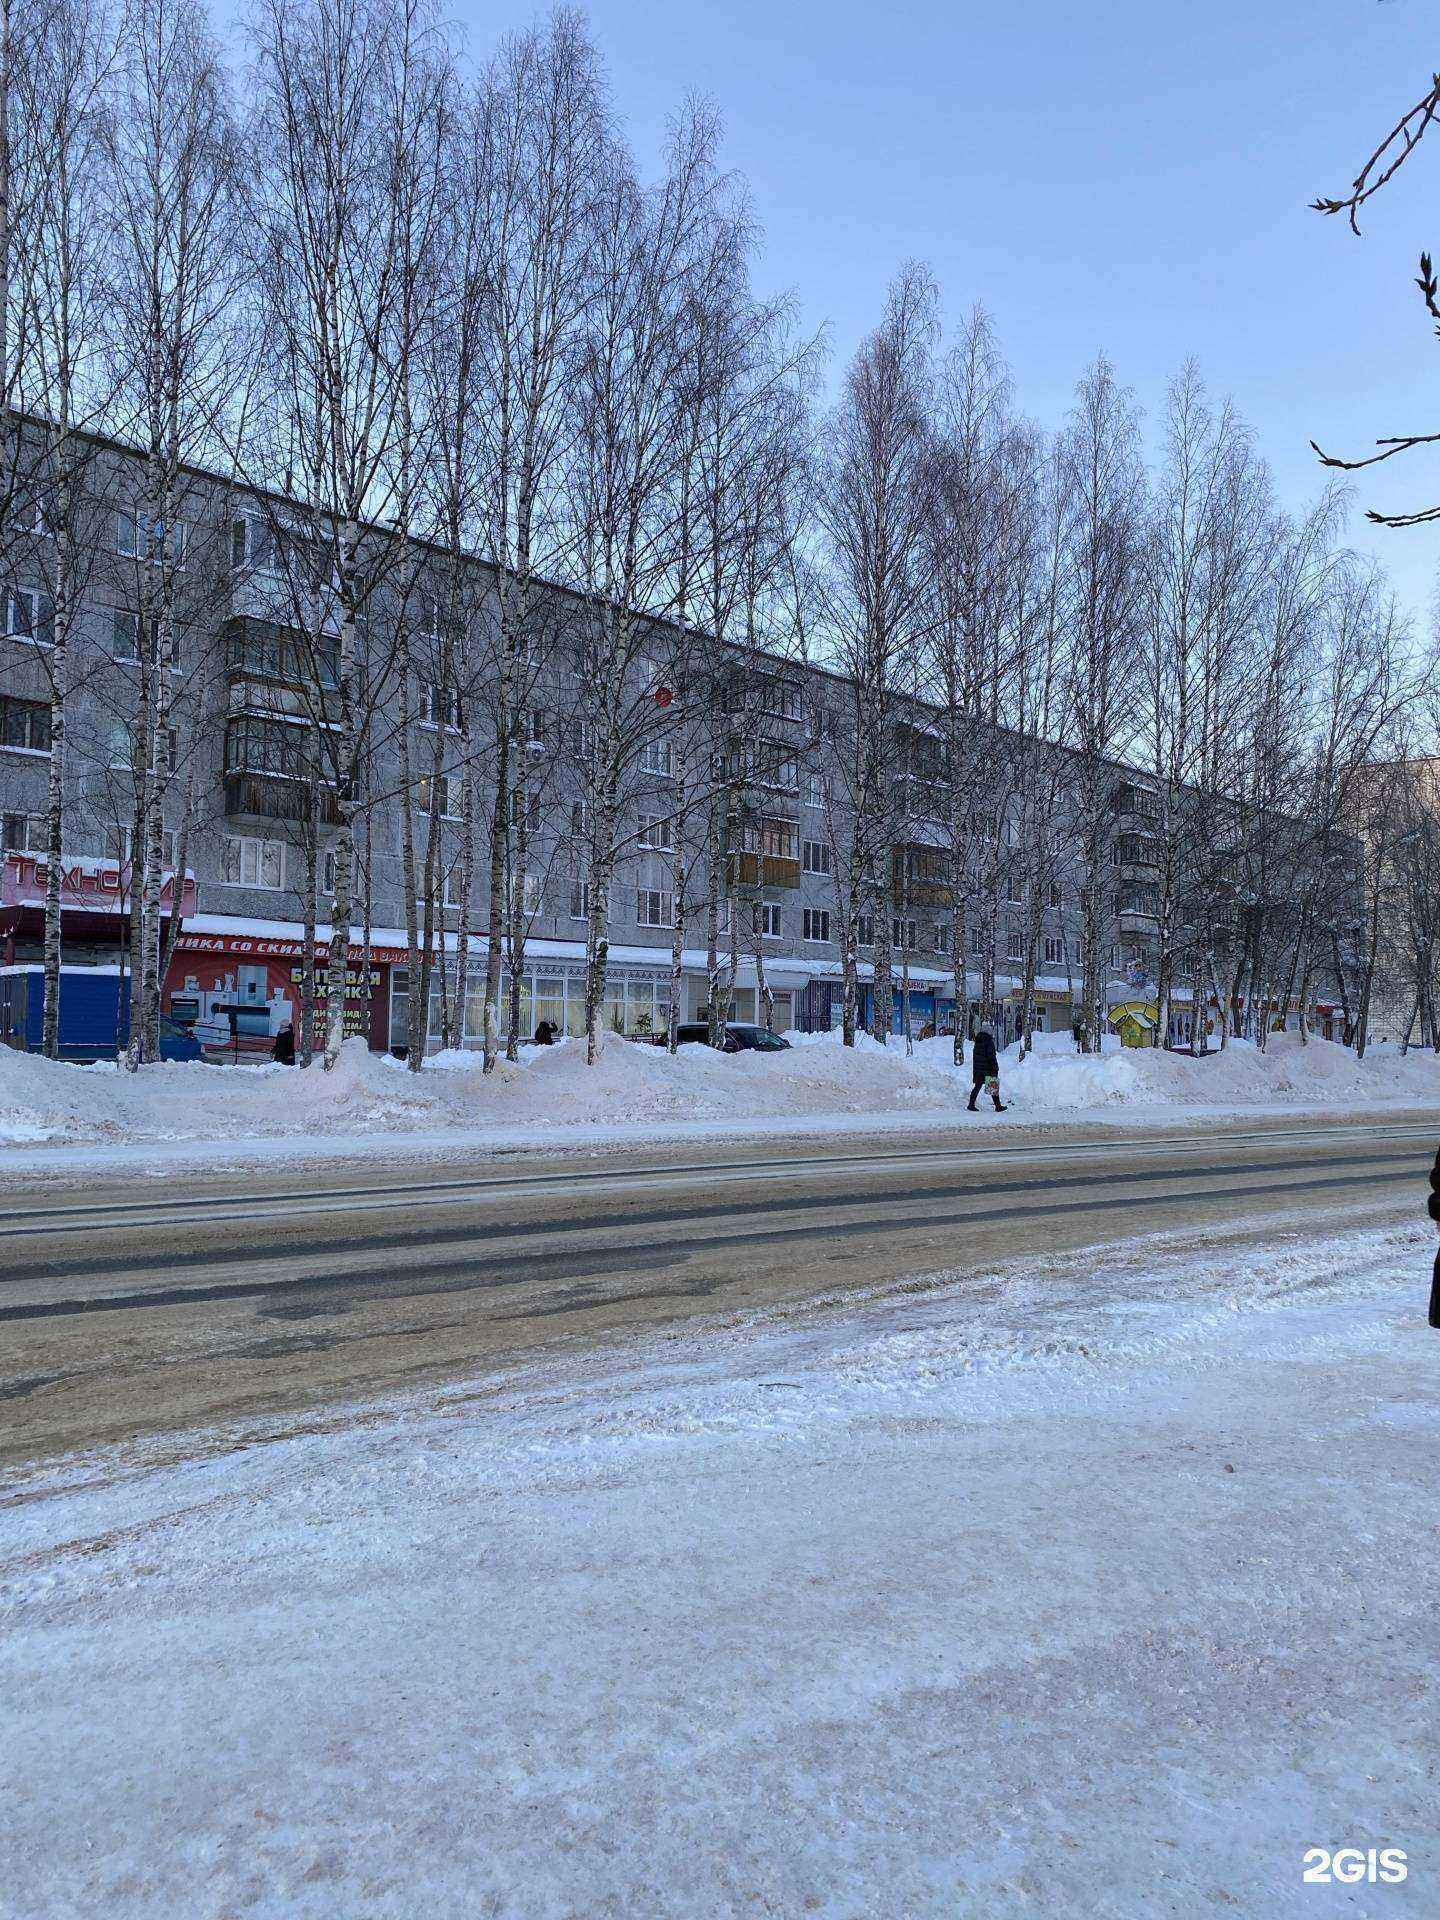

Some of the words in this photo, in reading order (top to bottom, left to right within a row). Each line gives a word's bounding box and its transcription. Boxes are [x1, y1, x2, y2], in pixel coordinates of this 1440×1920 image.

[7, 856, 195, 898] ТЕХНОИР
[229, 941, 253, 951] СО
[256, 943, 331, 957] СКИДО
[290, 967, 381, 986] БЫТВАЯ
